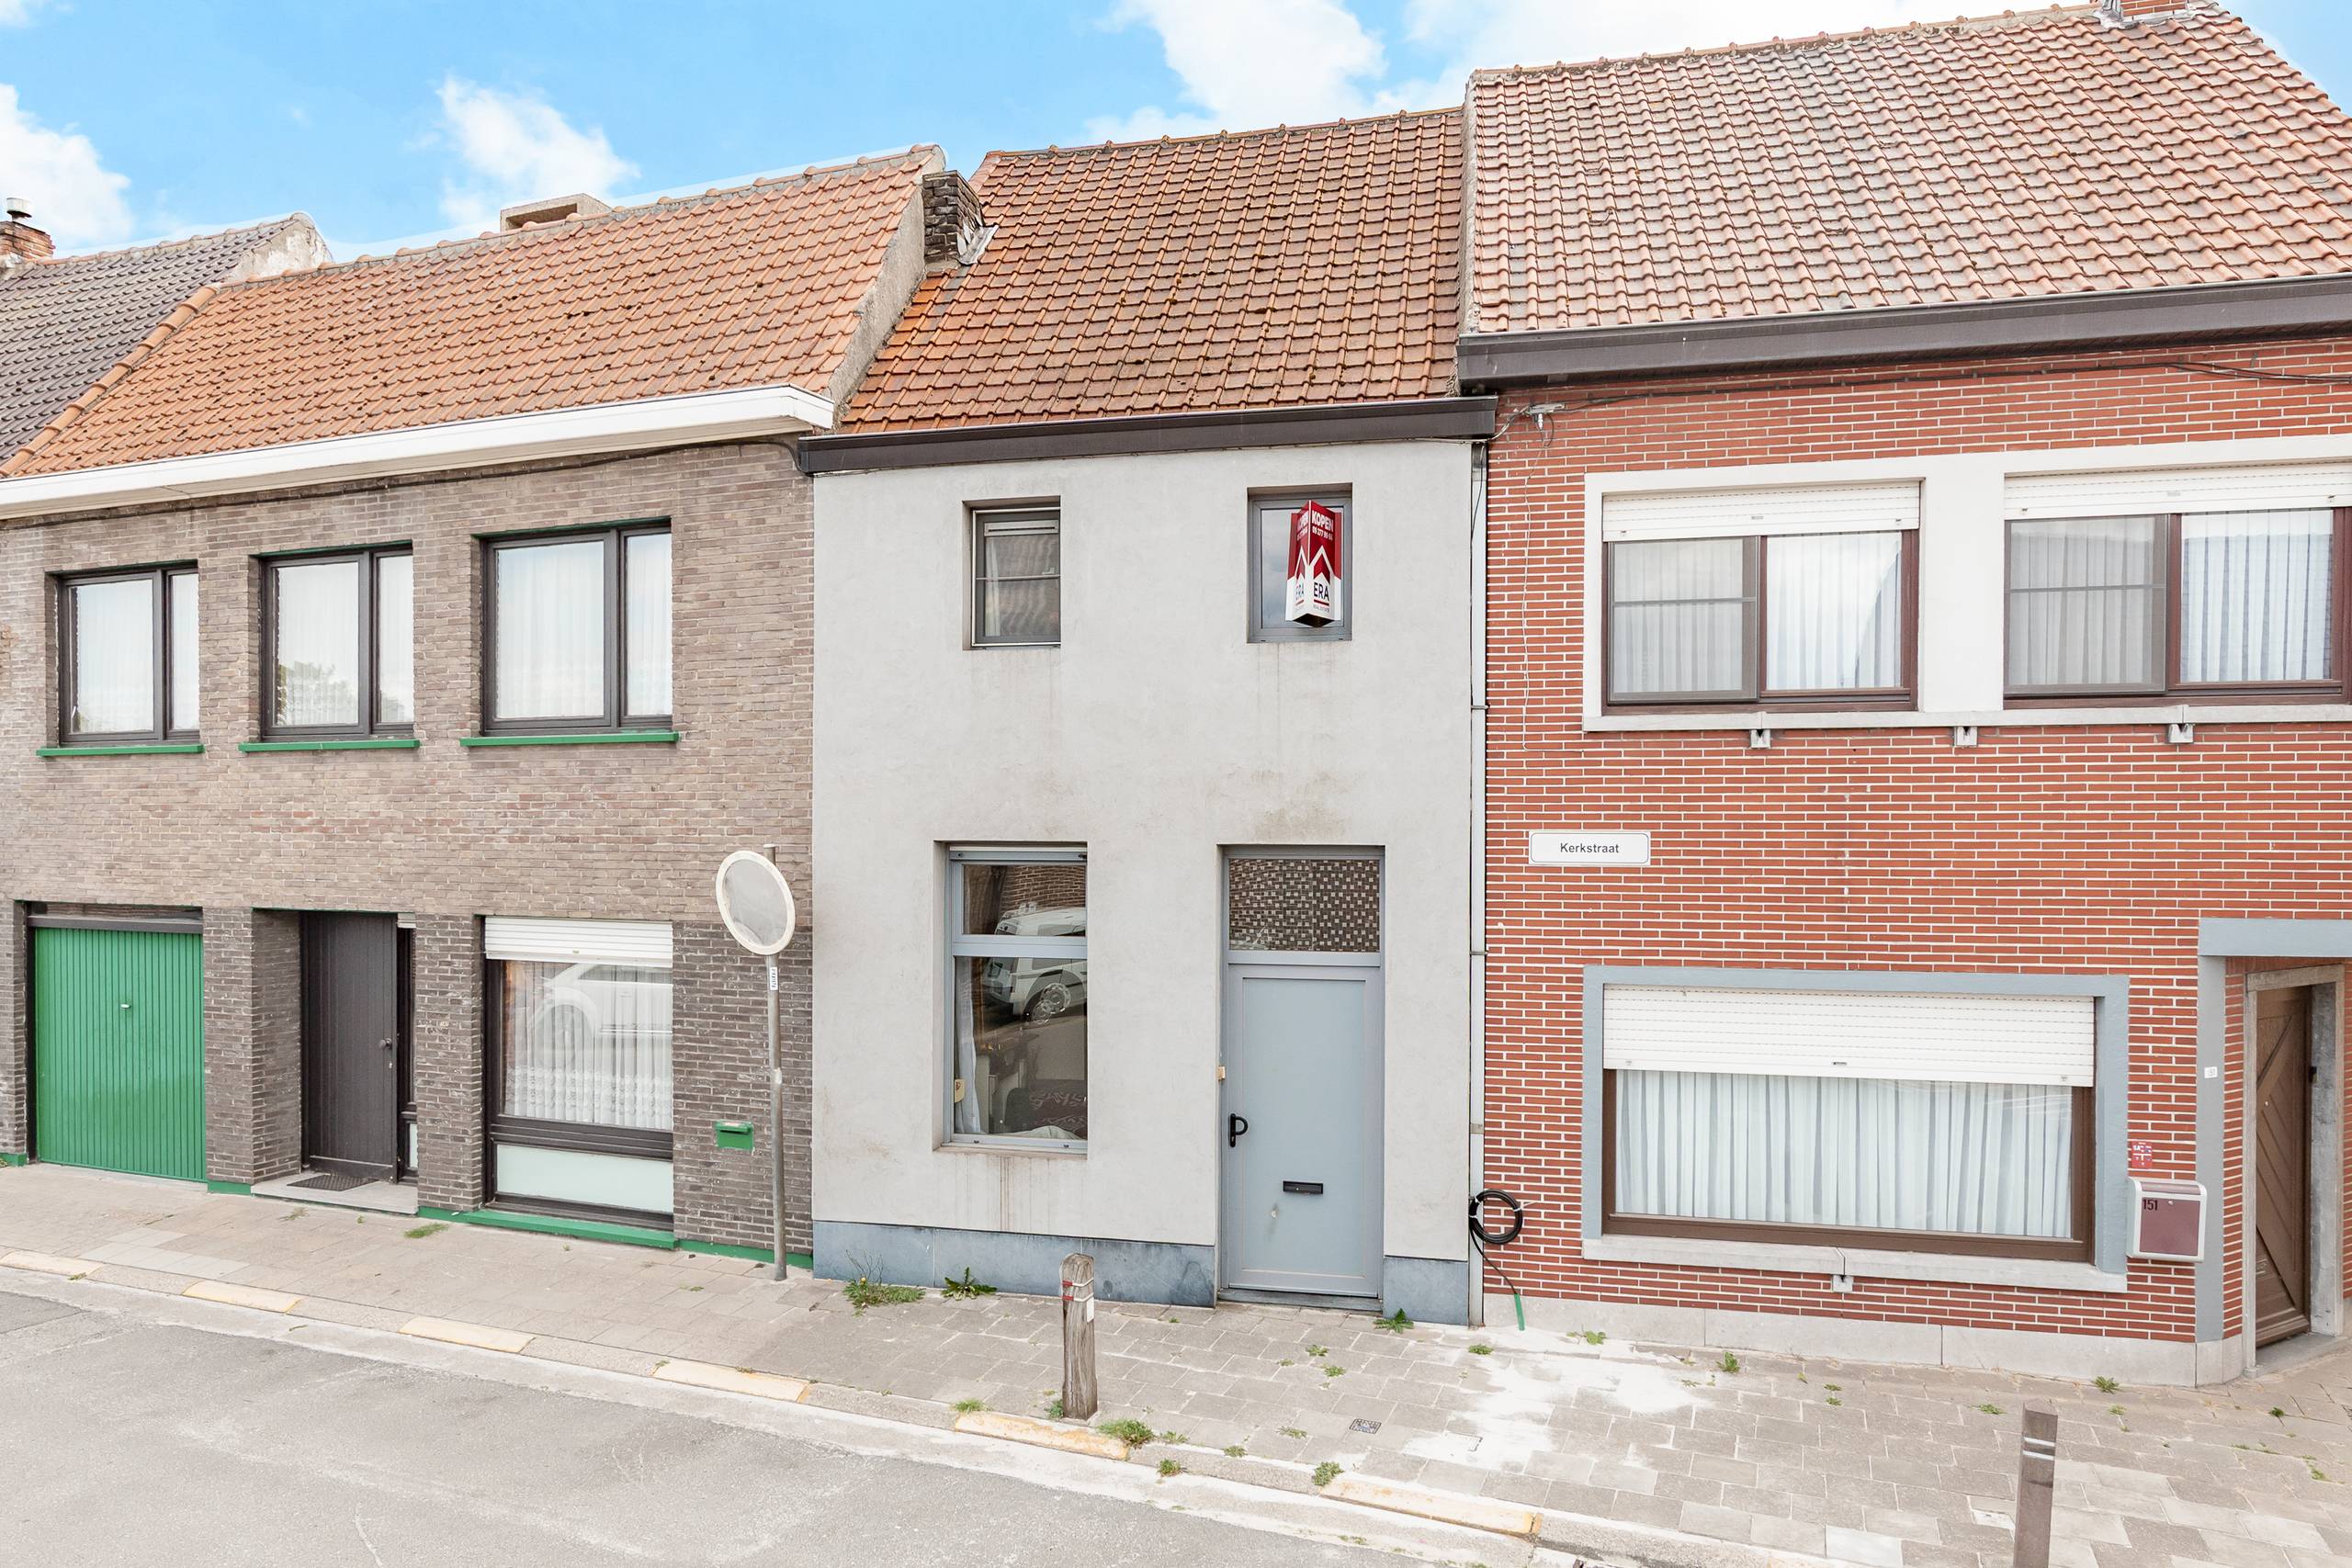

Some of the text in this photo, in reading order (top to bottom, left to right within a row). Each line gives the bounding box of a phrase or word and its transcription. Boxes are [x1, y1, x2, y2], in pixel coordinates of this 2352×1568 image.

[1312, 510, 1334, 533] KOPEN
[1314, 581, 1330, 602] ERA
[1560, 842, 1620, 853] Kerkstraat
[2143, 1199, 2158, 1211] 151
